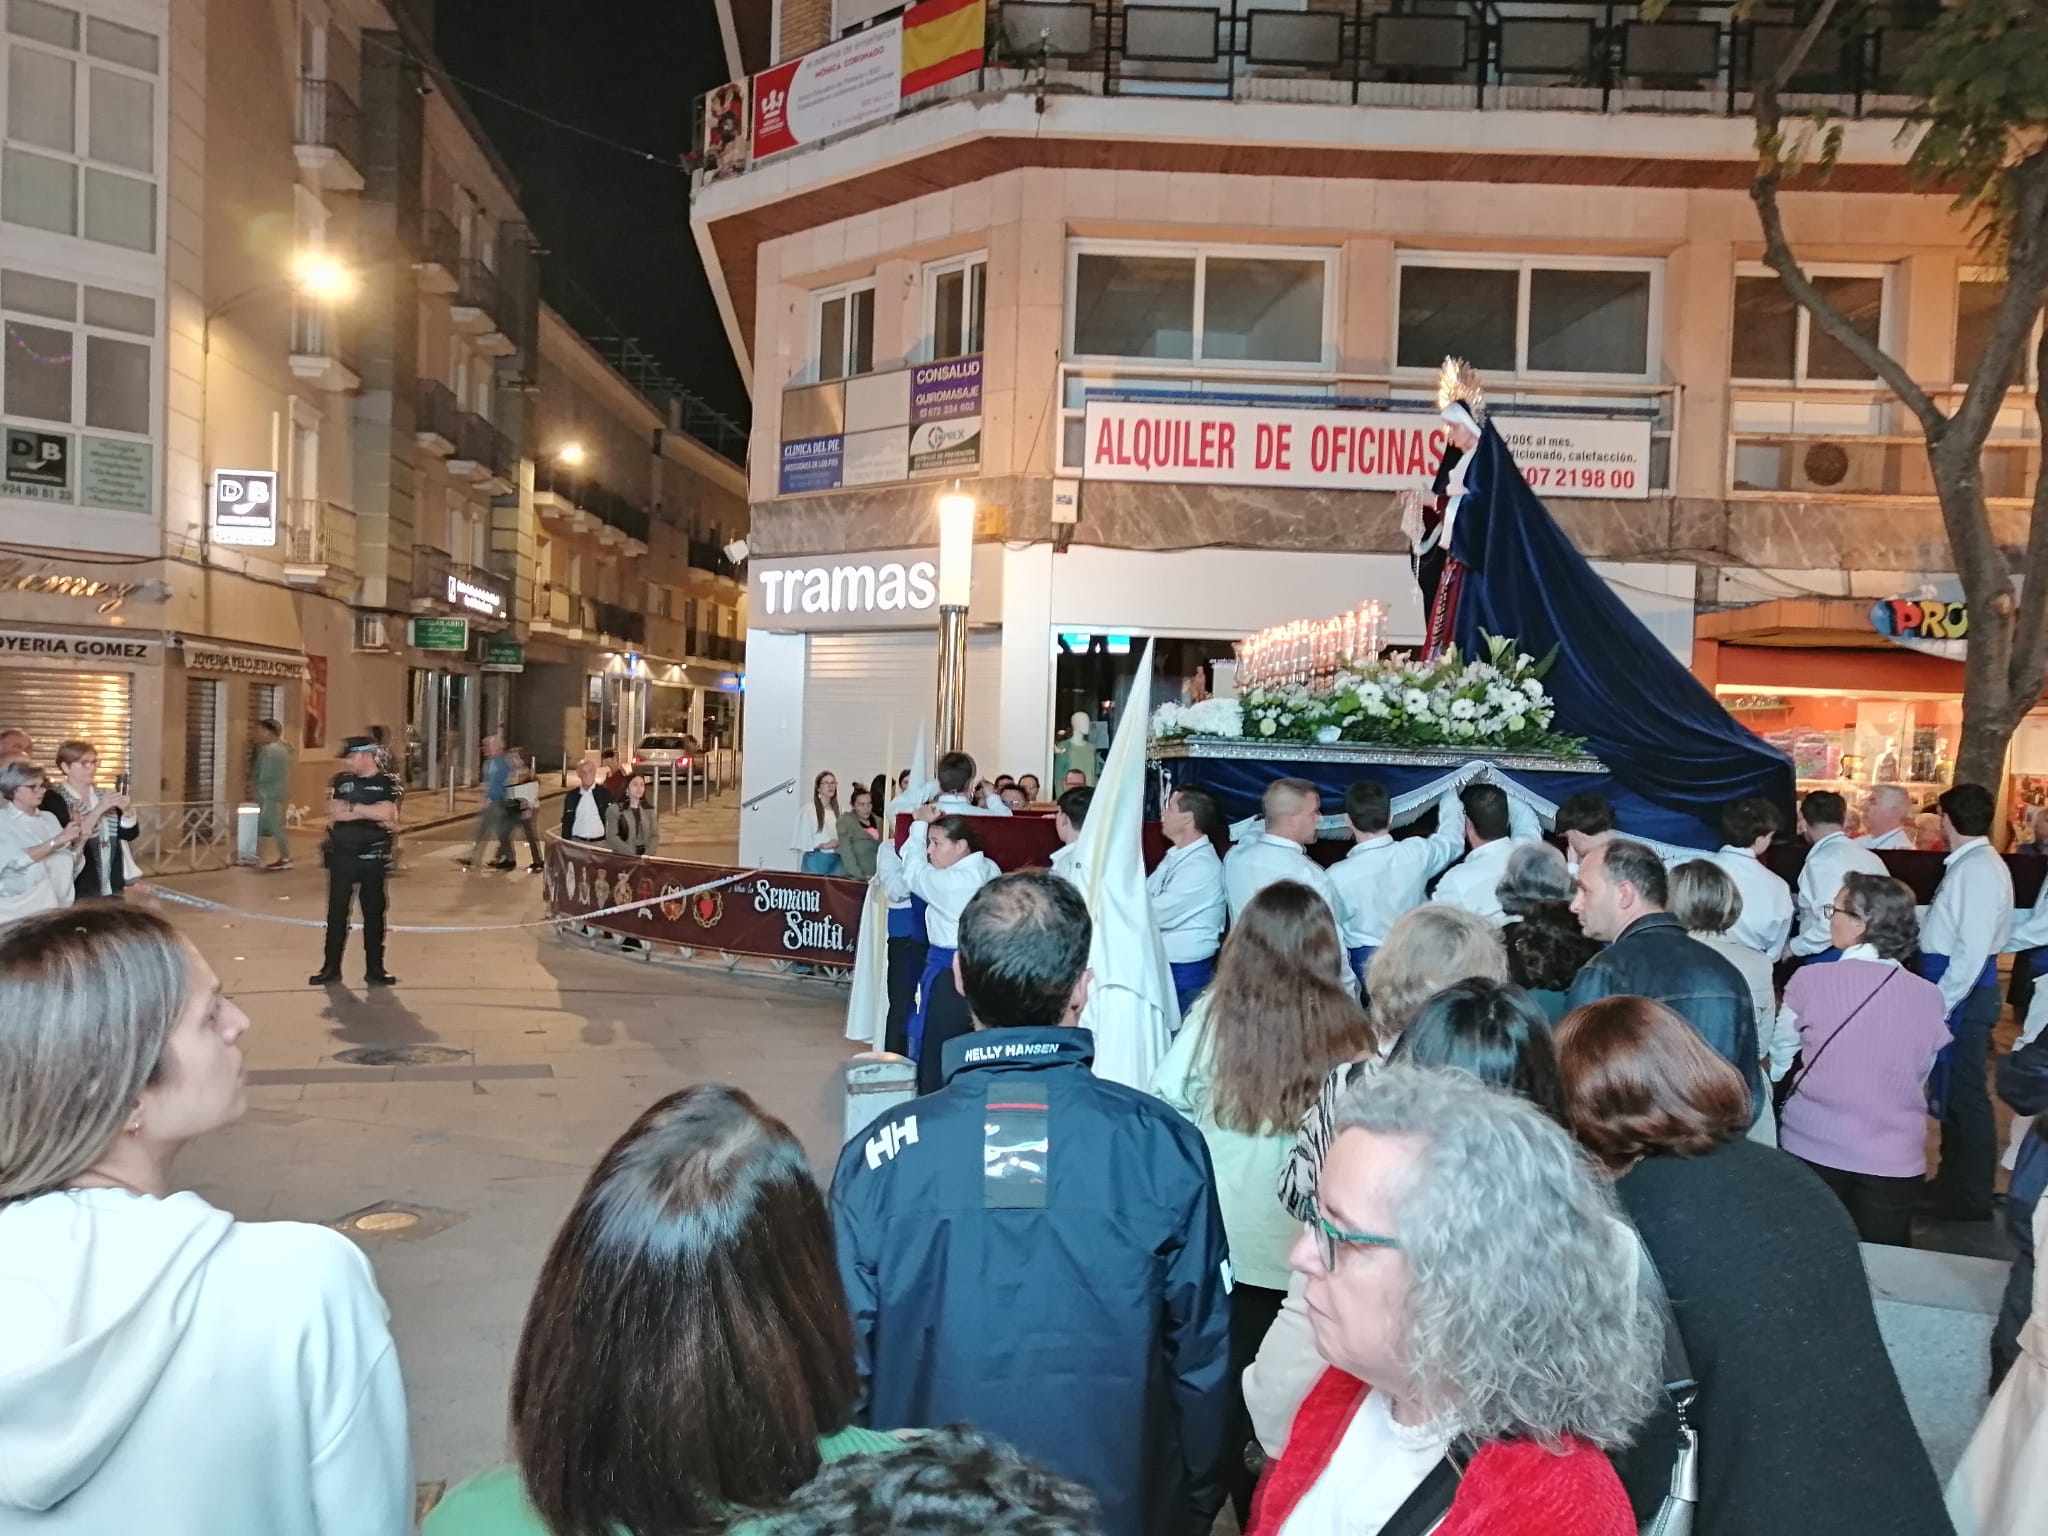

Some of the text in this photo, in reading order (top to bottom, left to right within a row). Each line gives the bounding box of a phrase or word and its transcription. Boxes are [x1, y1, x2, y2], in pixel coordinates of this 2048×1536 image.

[916, 360, 981, 385] CONSALUD
[915, 384, 981, 406] QUIROMASAJE
[1095, 417, 1446, 477] ALQUILER DE OFICINAS
[1535, 436, 1546, 446] al
[1548, 438, 1574, 447] mes.
[1567, 451, 1637, 463] calefacción.
[1519, 467, 1551, 487] 07
[1610, 470, 1635, 489] 00
[0, 636, 148, 658] YERIA GOMEZ
[754, 879, 821, 912] Semana
[782, 910, 844, 951] Santa
[964, 1043, 1060, 1062] HELLY HANSEN
[865, 1114, 919, 1171] HH
